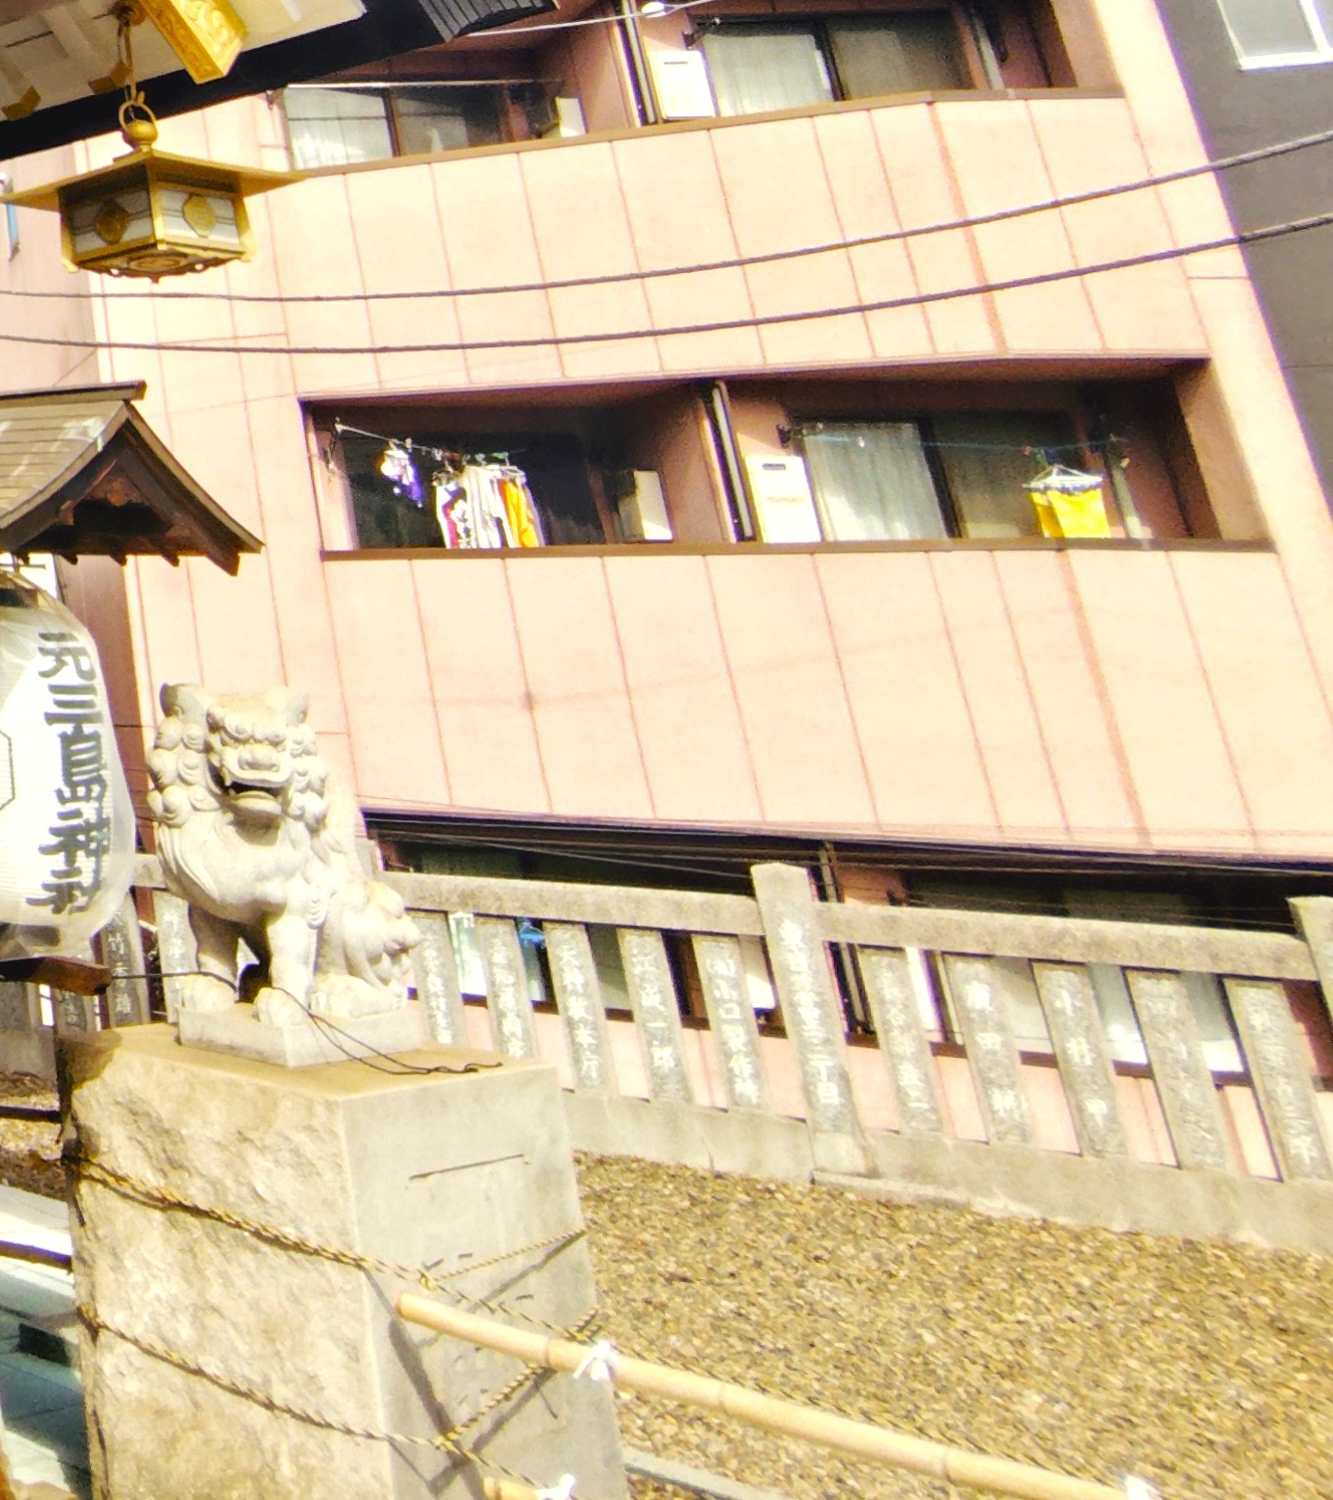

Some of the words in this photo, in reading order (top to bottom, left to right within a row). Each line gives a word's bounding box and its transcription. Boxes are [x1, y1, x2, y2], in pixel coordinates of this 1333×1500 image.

[25, 632, 111, 916] 元三島神社
